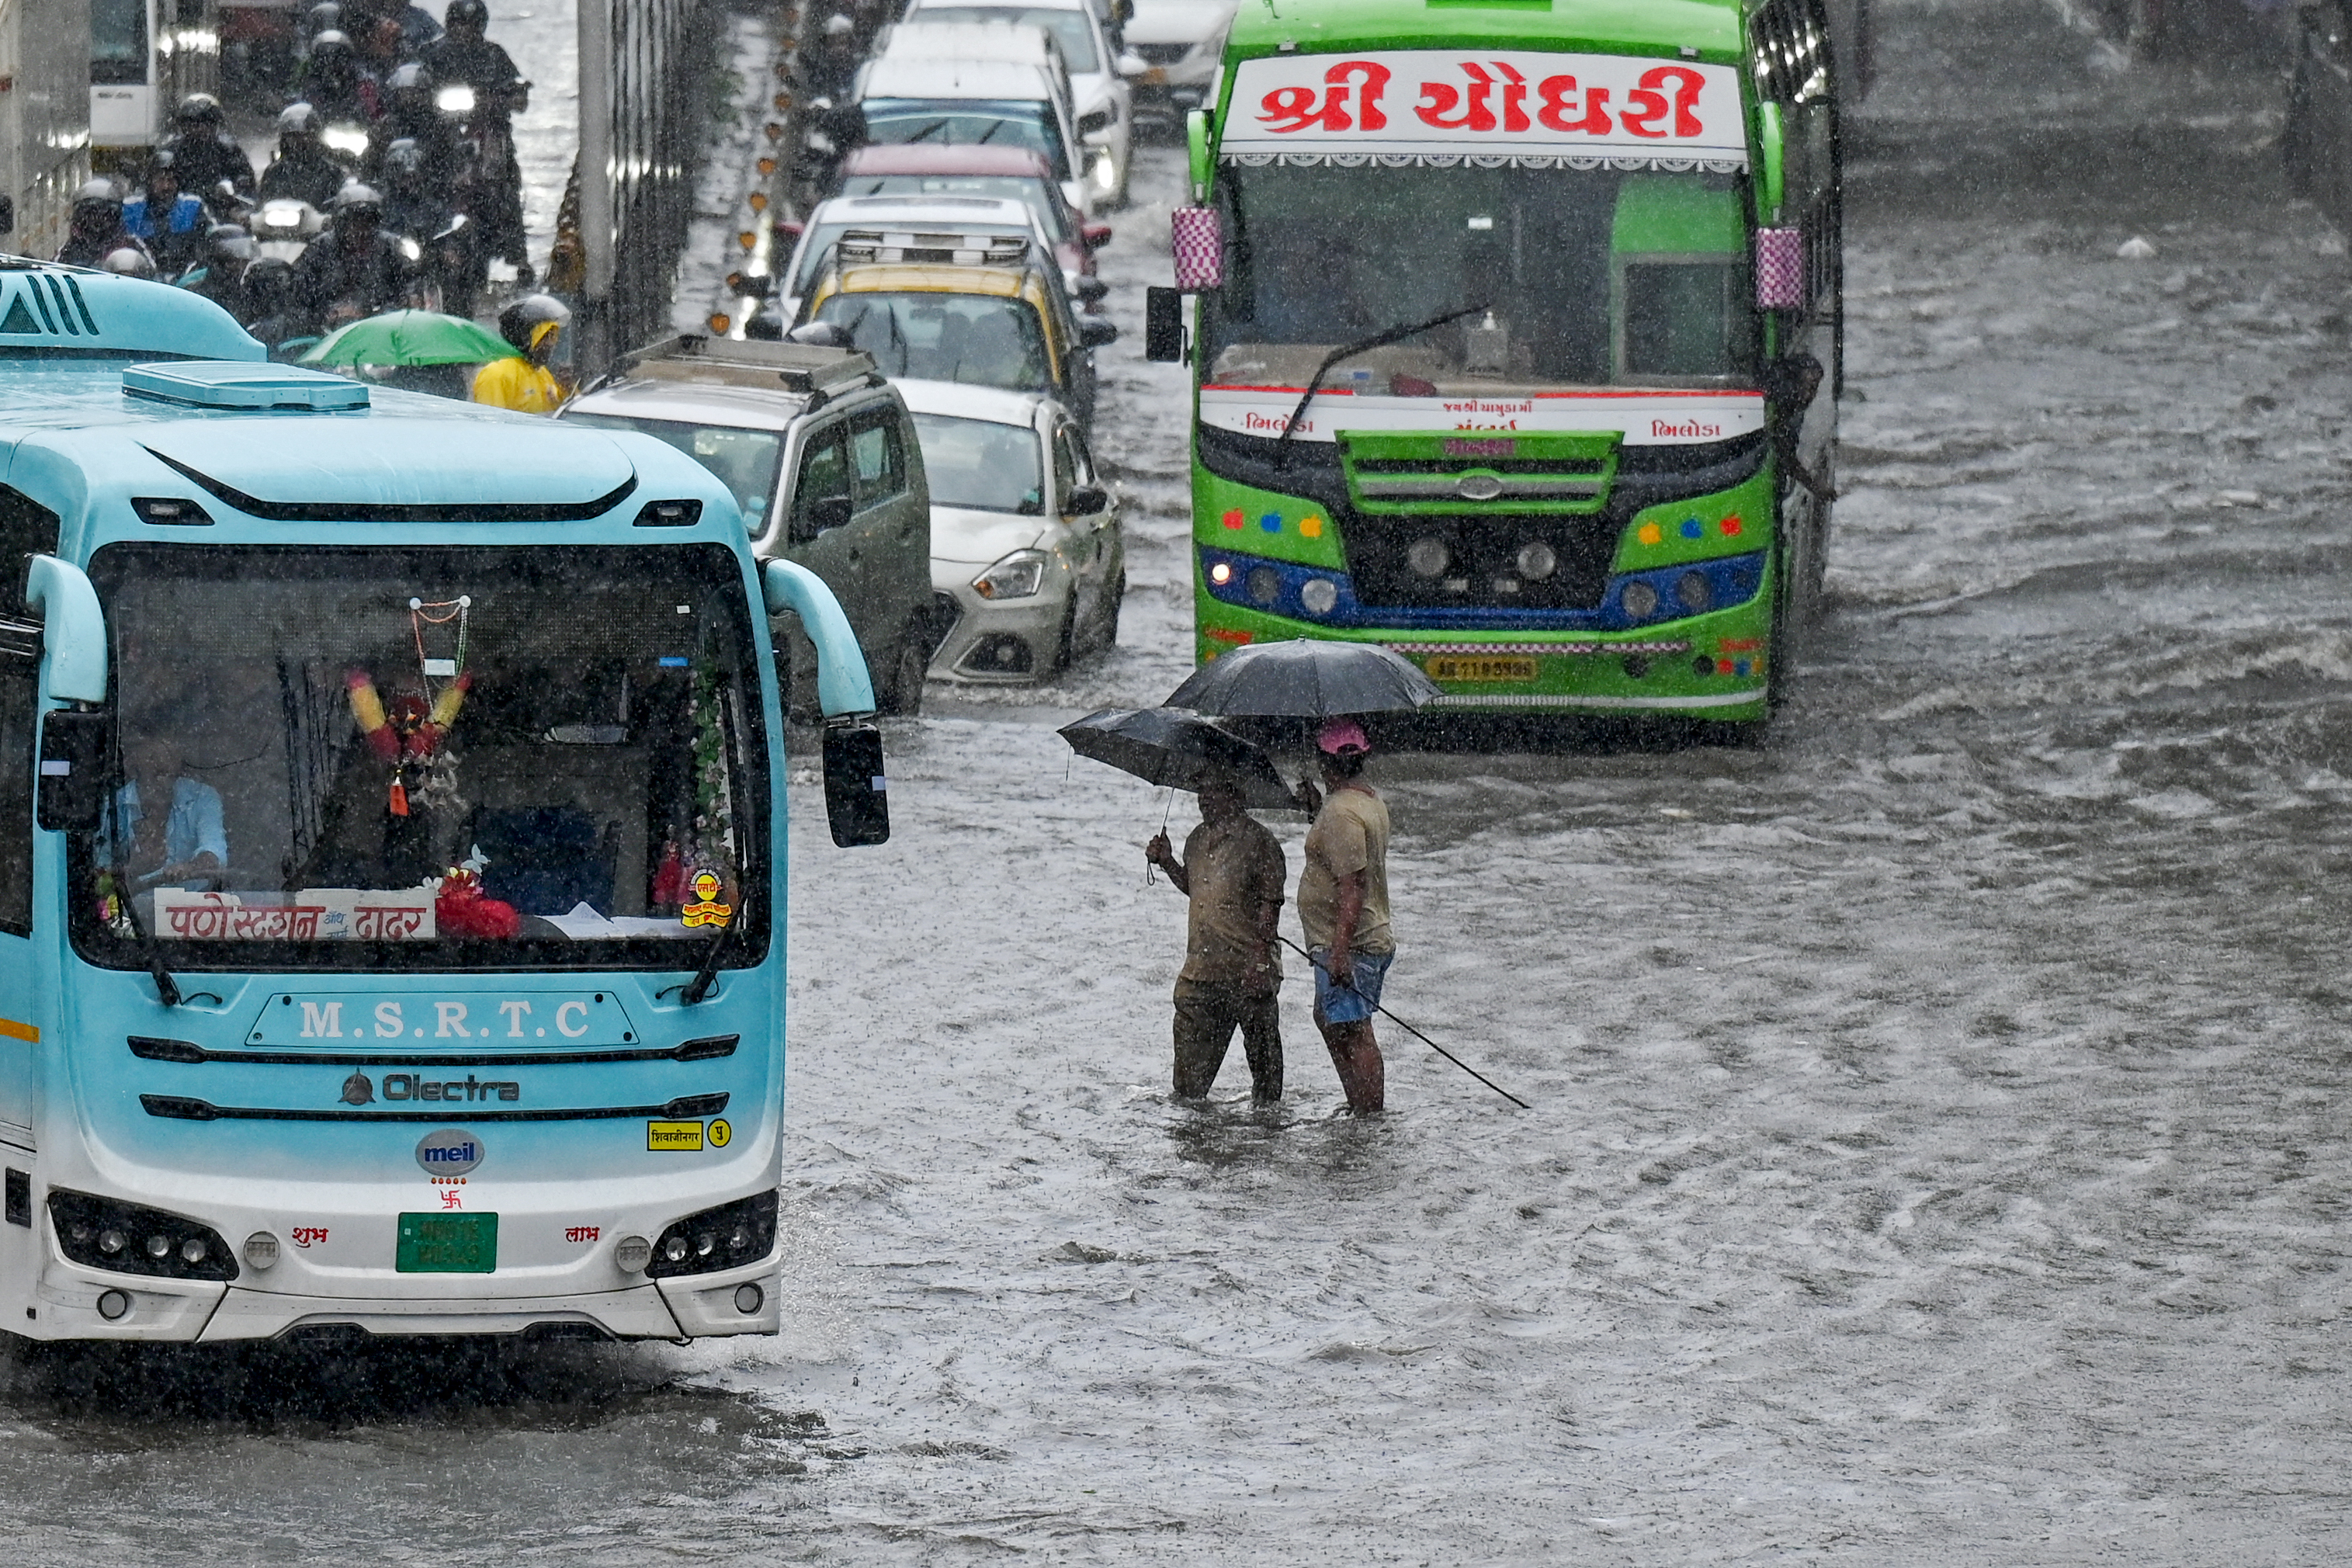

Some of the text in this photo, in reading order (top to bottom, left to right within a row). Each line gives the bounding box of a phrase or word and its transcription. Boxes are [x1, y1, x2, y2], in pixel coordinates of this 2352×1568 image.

[1254, 61, 1706, 138] શ્રી ચૌધરી
[1652, 419, 1721, 437] ભિલોડા
[165, 893, 427, 940] पणे स्टशन दादर
[300, 1001, 588, 1038] M.S.R.T.C
[382, 1073, 520, 1101] Olectra
[651, 1129, 700, 1143] शिवाजीनगर
[715, 1126, 723, 1140] पु
[425, 1142, 475, 1162] meil
[292, 1227, 329, 1248] शुभ
[565, 1226, 600, 1242] लाभ
